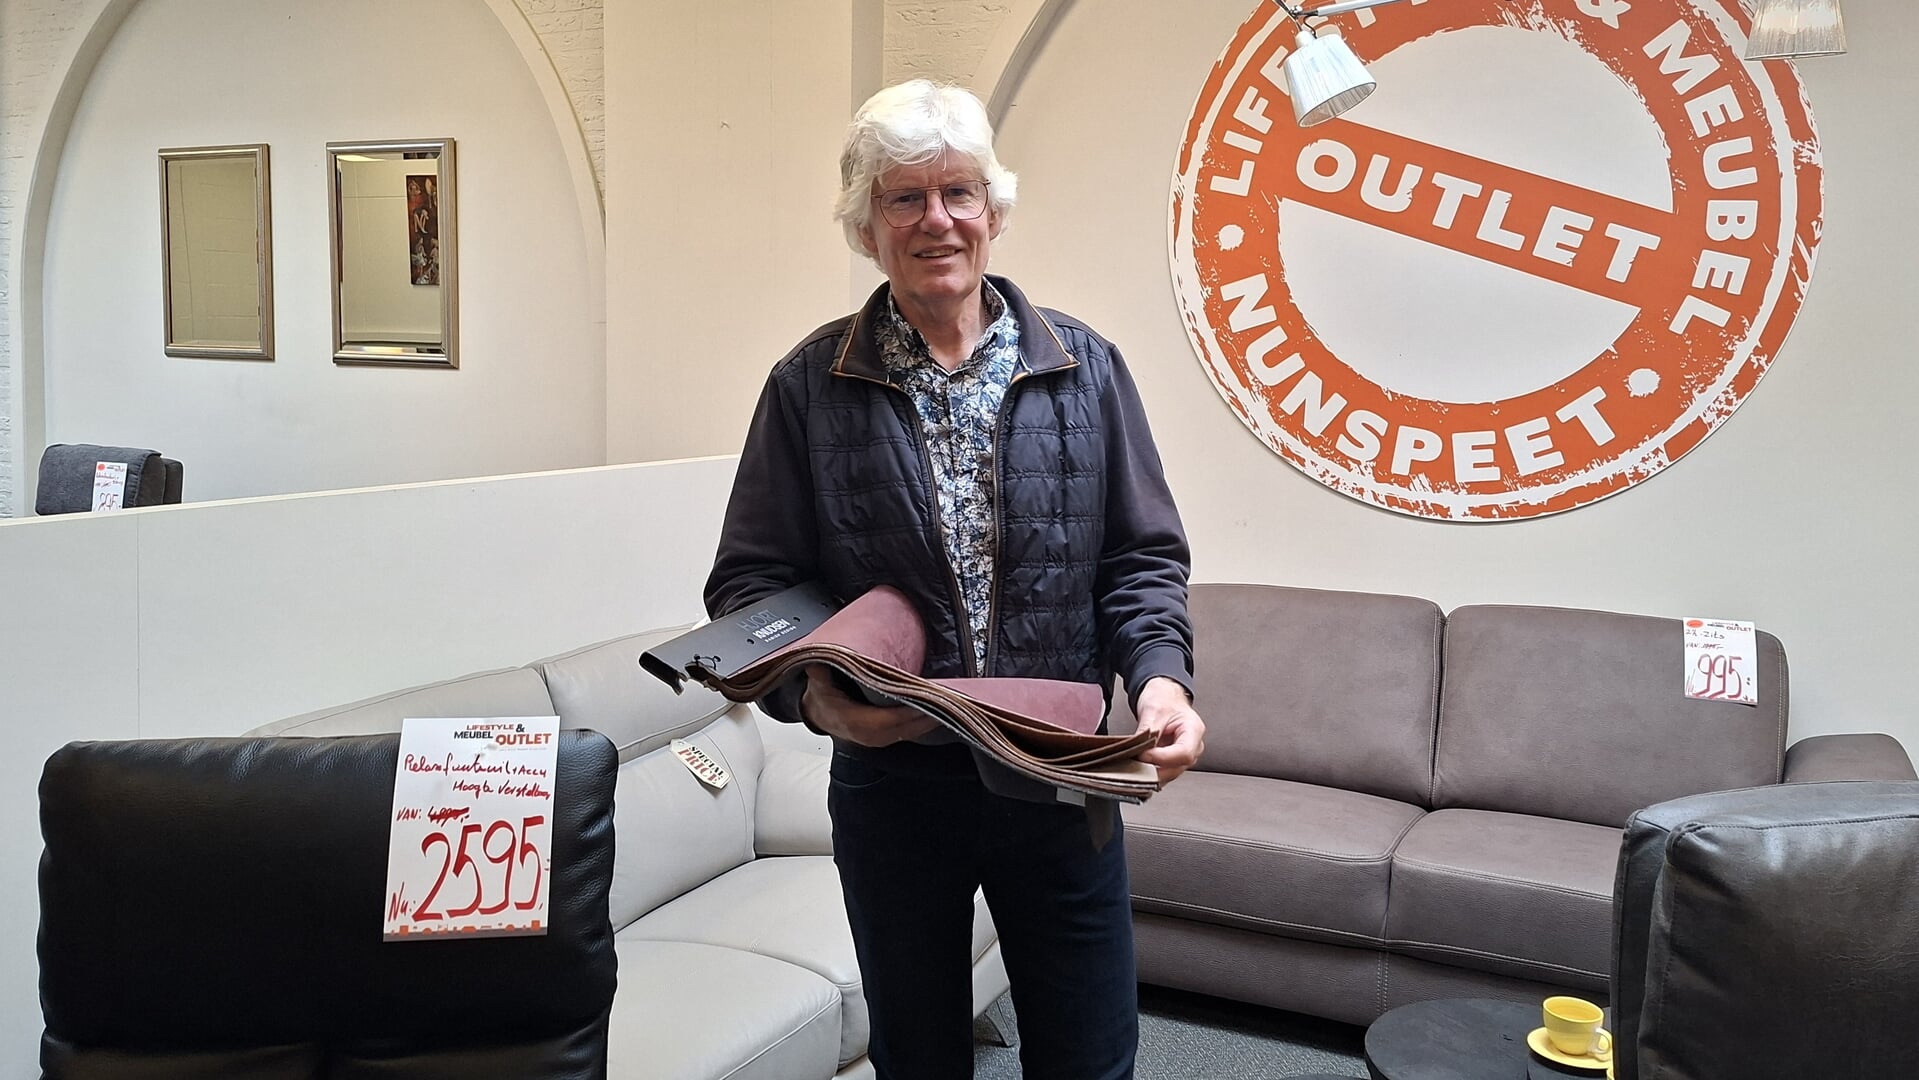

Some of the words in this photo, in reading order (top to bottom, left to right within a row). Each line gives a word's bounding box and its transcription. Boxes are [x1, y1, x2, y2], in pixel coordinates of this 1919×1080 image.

[1642, 18, 1758, 335] MEUBEL
[1296, 138, 1661, 283] OUTLET
[1219, 272, 1616, 482] NUNSPEET
[454, 731, 493, 739] MEUBEL
[495, 733, 552, 745] OUTLET
[516, 723, 525, 733] &
[677, 749, 721, 784] PRICE
[688, 746, 724, 778] SPECIAL
